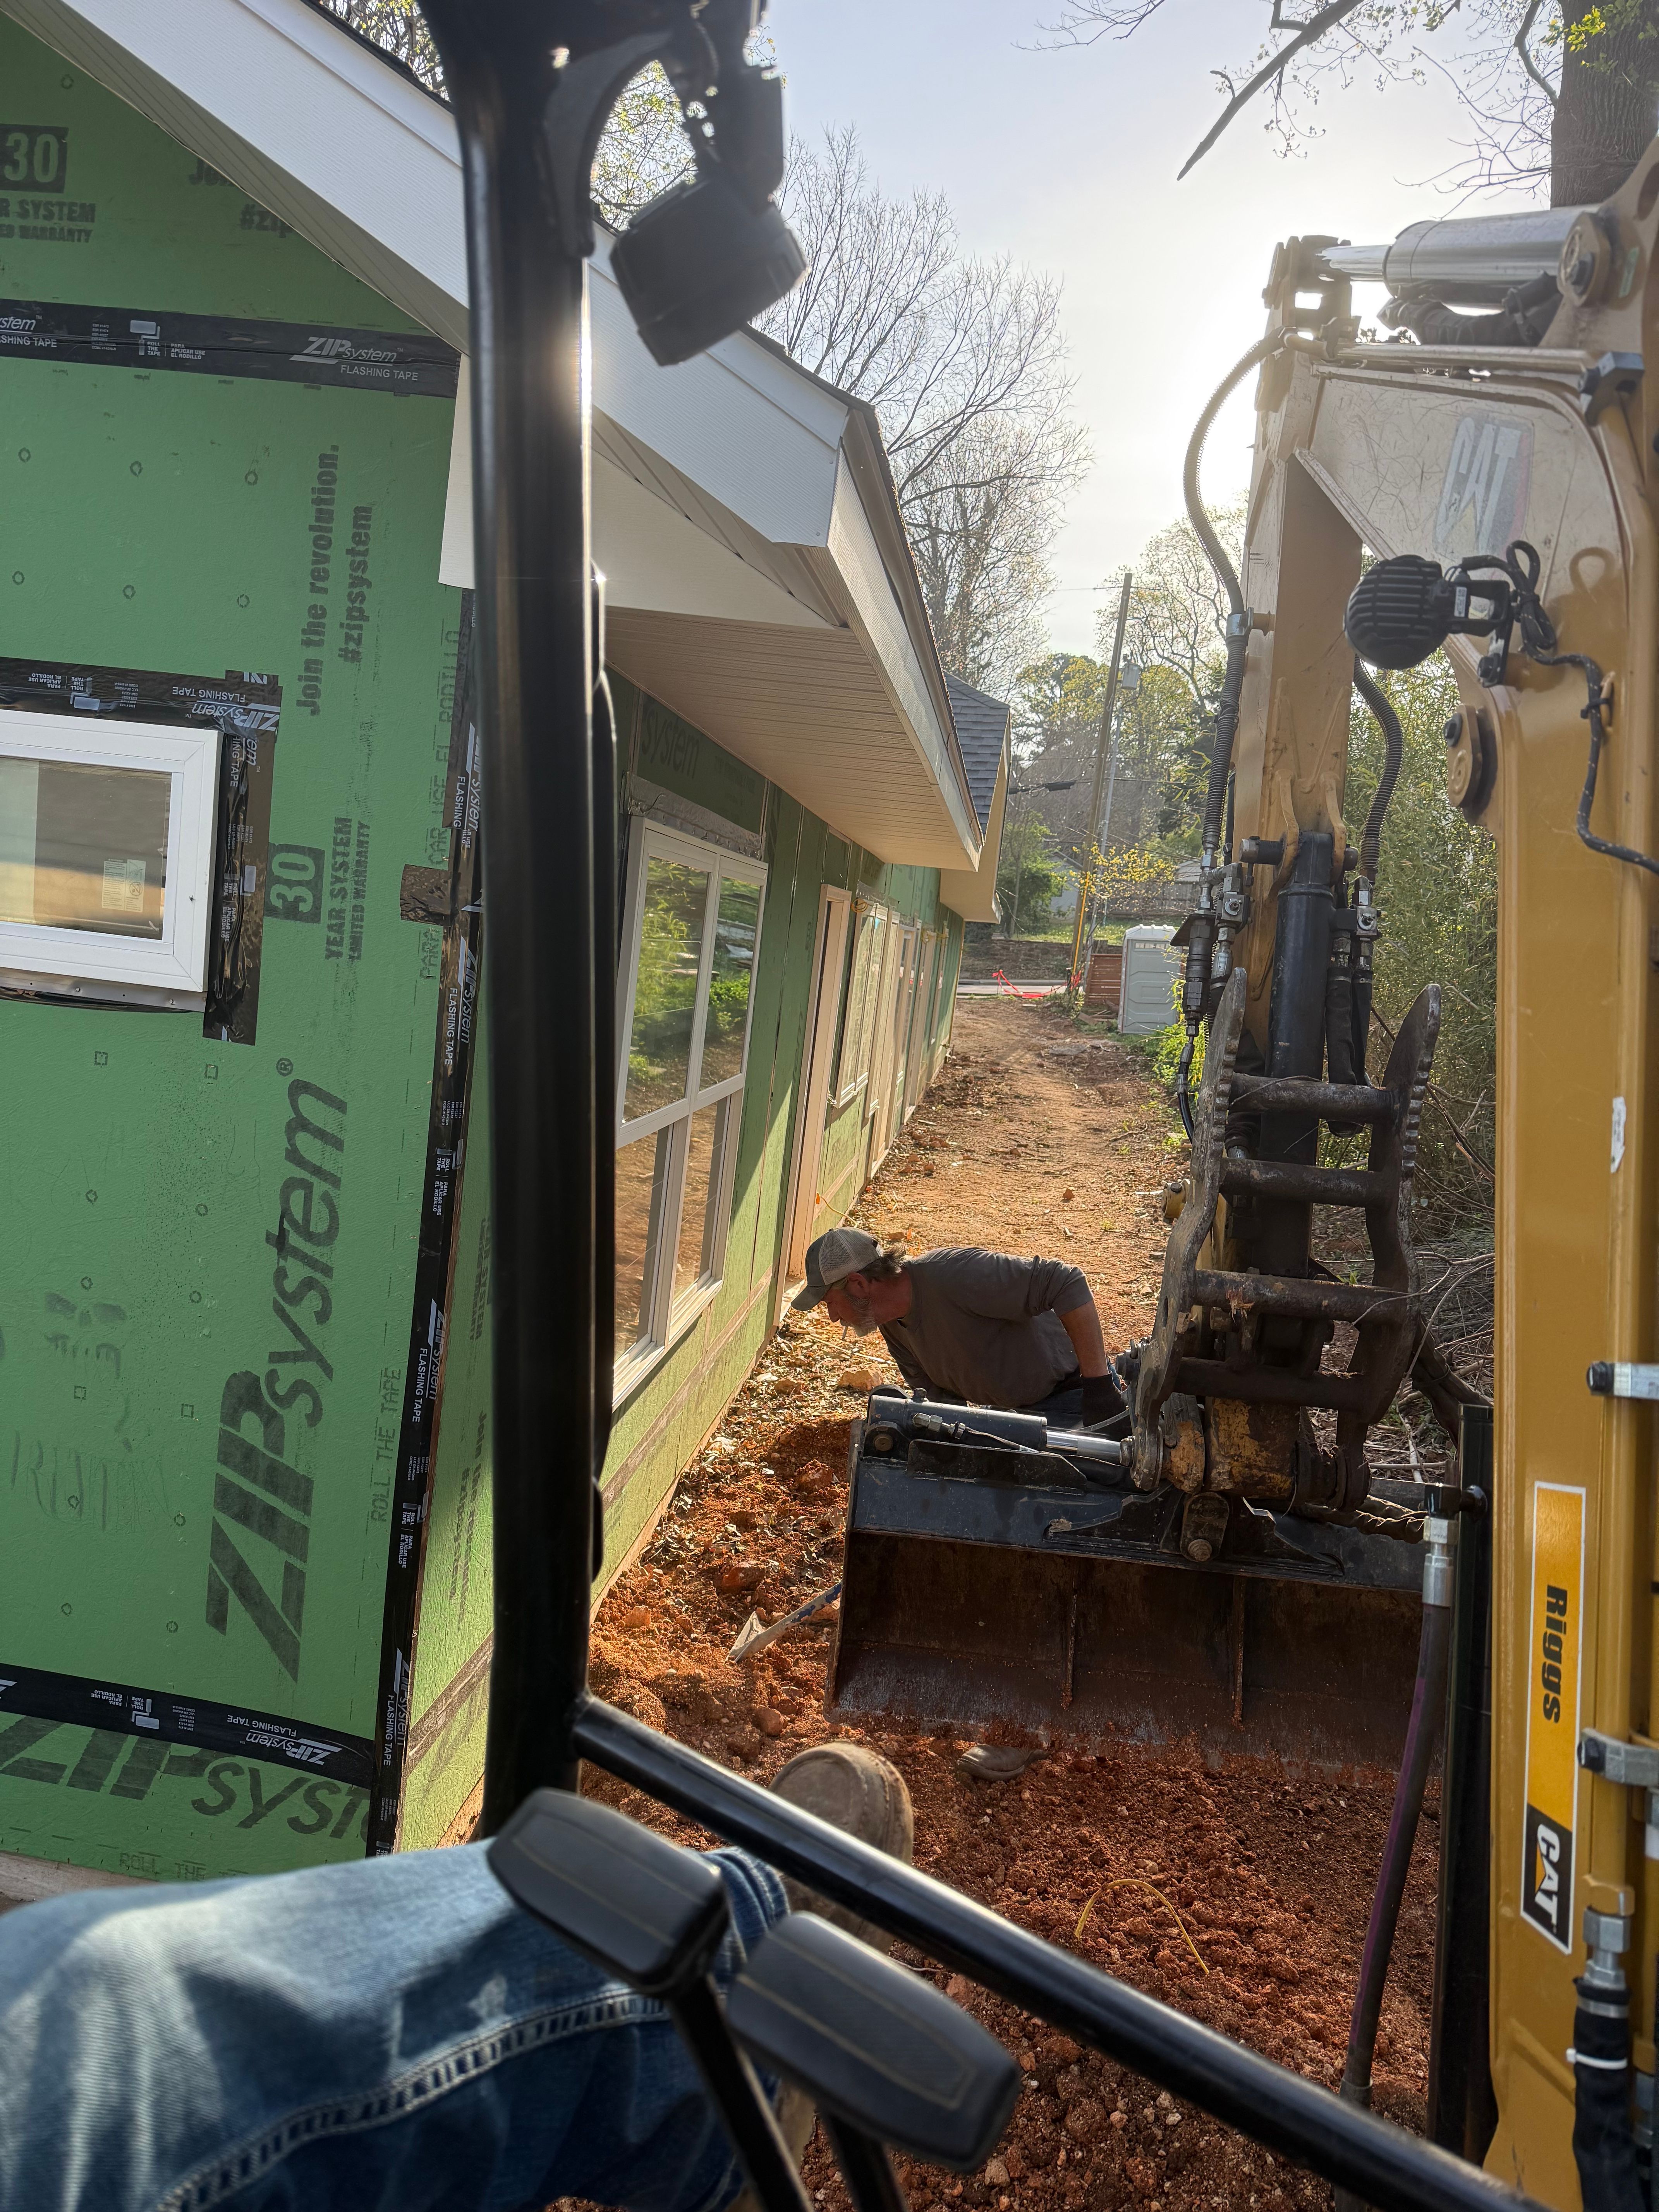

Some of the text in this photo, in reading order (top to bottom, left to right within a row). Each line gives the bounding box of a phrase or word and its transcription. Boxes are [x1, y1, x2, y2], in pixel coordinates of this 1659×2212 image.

[4, 132, 58, 182] 30
[17, 199, 96, 223] SYSTEM
[33, 338, 57, 347] TAPE
[341, 365, 418, 381] FLASHING TAPE
[1436, 417, 1521, 555] CAT
[338, 506, 372, 663] #zipsystem
[301, 604, 327, 648] the
[172, 687, 245, 702] FLASHING TAPE
[296, 658, 323, 716] Join
[230, 760, 239, 787] TAPE
[453, 776, 465, 828] FLASHING
[270, 852, 315, 913] 30
[325, 816, 352, 960] YEAR SYSTEM
[445, 988, 458, 1066] FLASHING TAPE
[412, 1348, 428, 1423] FLASHING TAPE
[376, 1427, 395, 1461] THE
[370, 1477, 390, 1522] ROLL
[1543, 1584, 1568, 1724] Riggs
[227, 1715, 297, 1737] FLASHING TAPE
[383, 1694, 394, 1766] FLASHING TAPE
[1536, 1823, 1559, 1932] CAT
